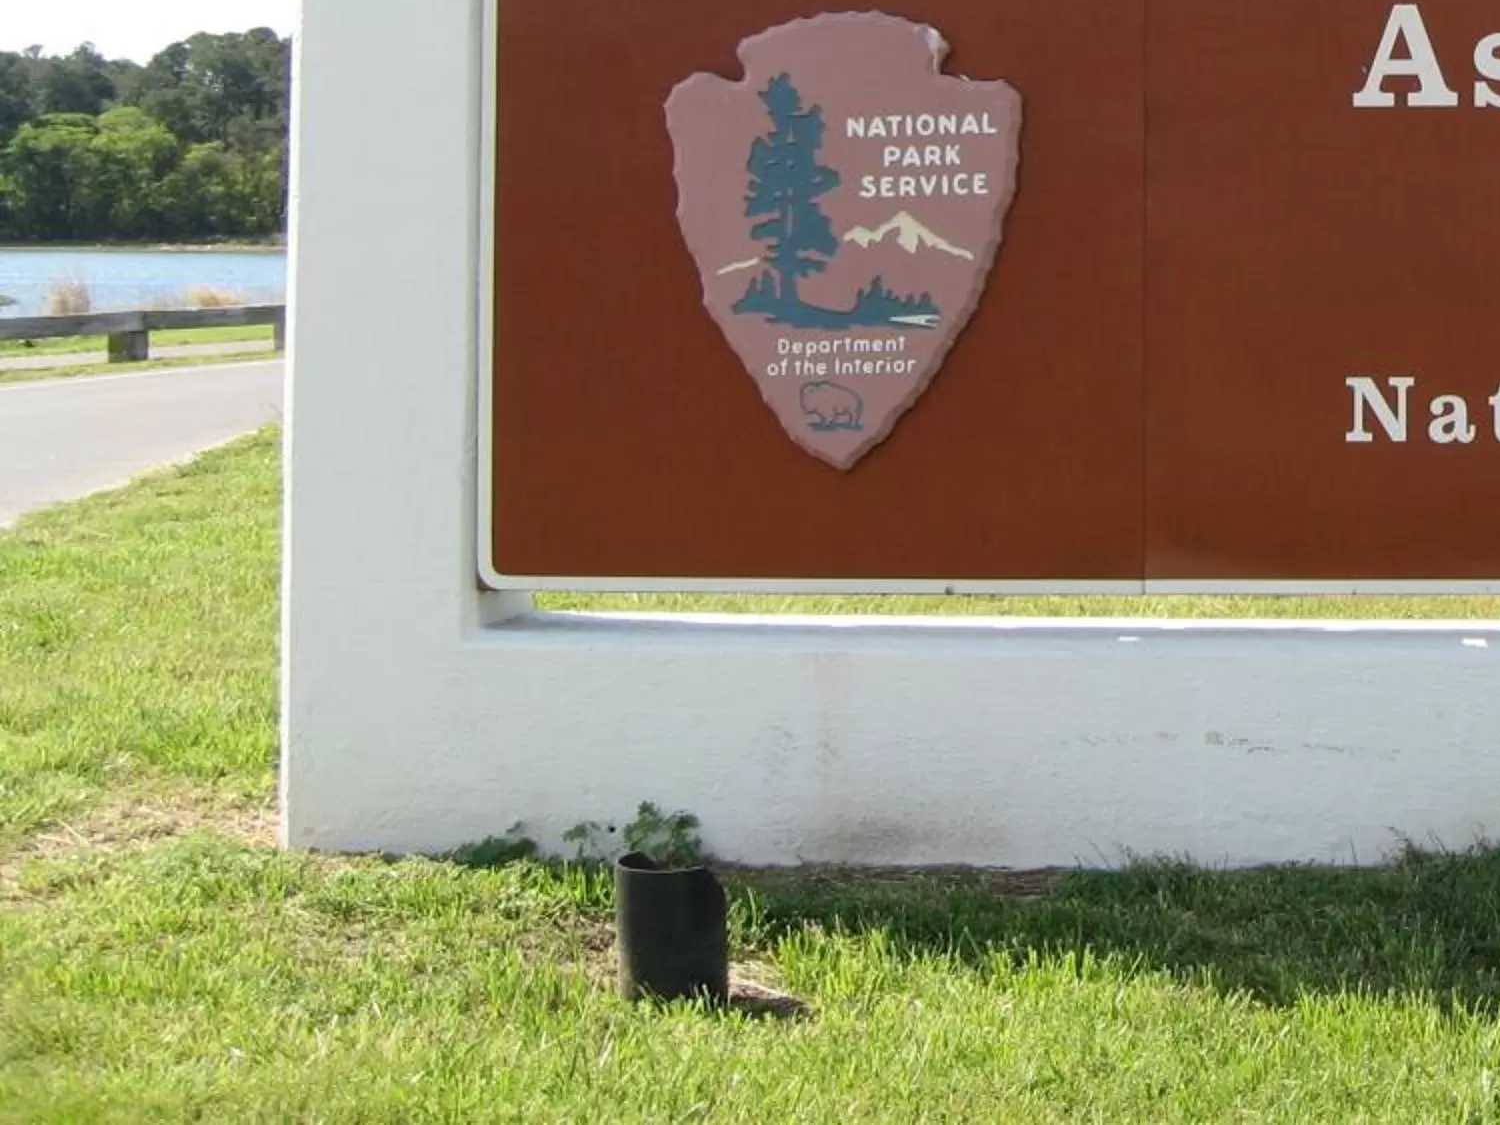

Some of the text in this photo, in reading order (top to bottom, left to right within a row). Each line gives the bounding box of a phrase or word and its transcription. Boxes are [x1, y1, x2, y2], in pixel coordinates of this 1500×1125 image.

[846, 112, 998, 139] NATIONAL
[883, 144, 961, 167] PARK
[859, 173, 989, 198] SERVICE
[777, 335, 906, 358] Department
[767, 357, 917, 376] of the Interior
